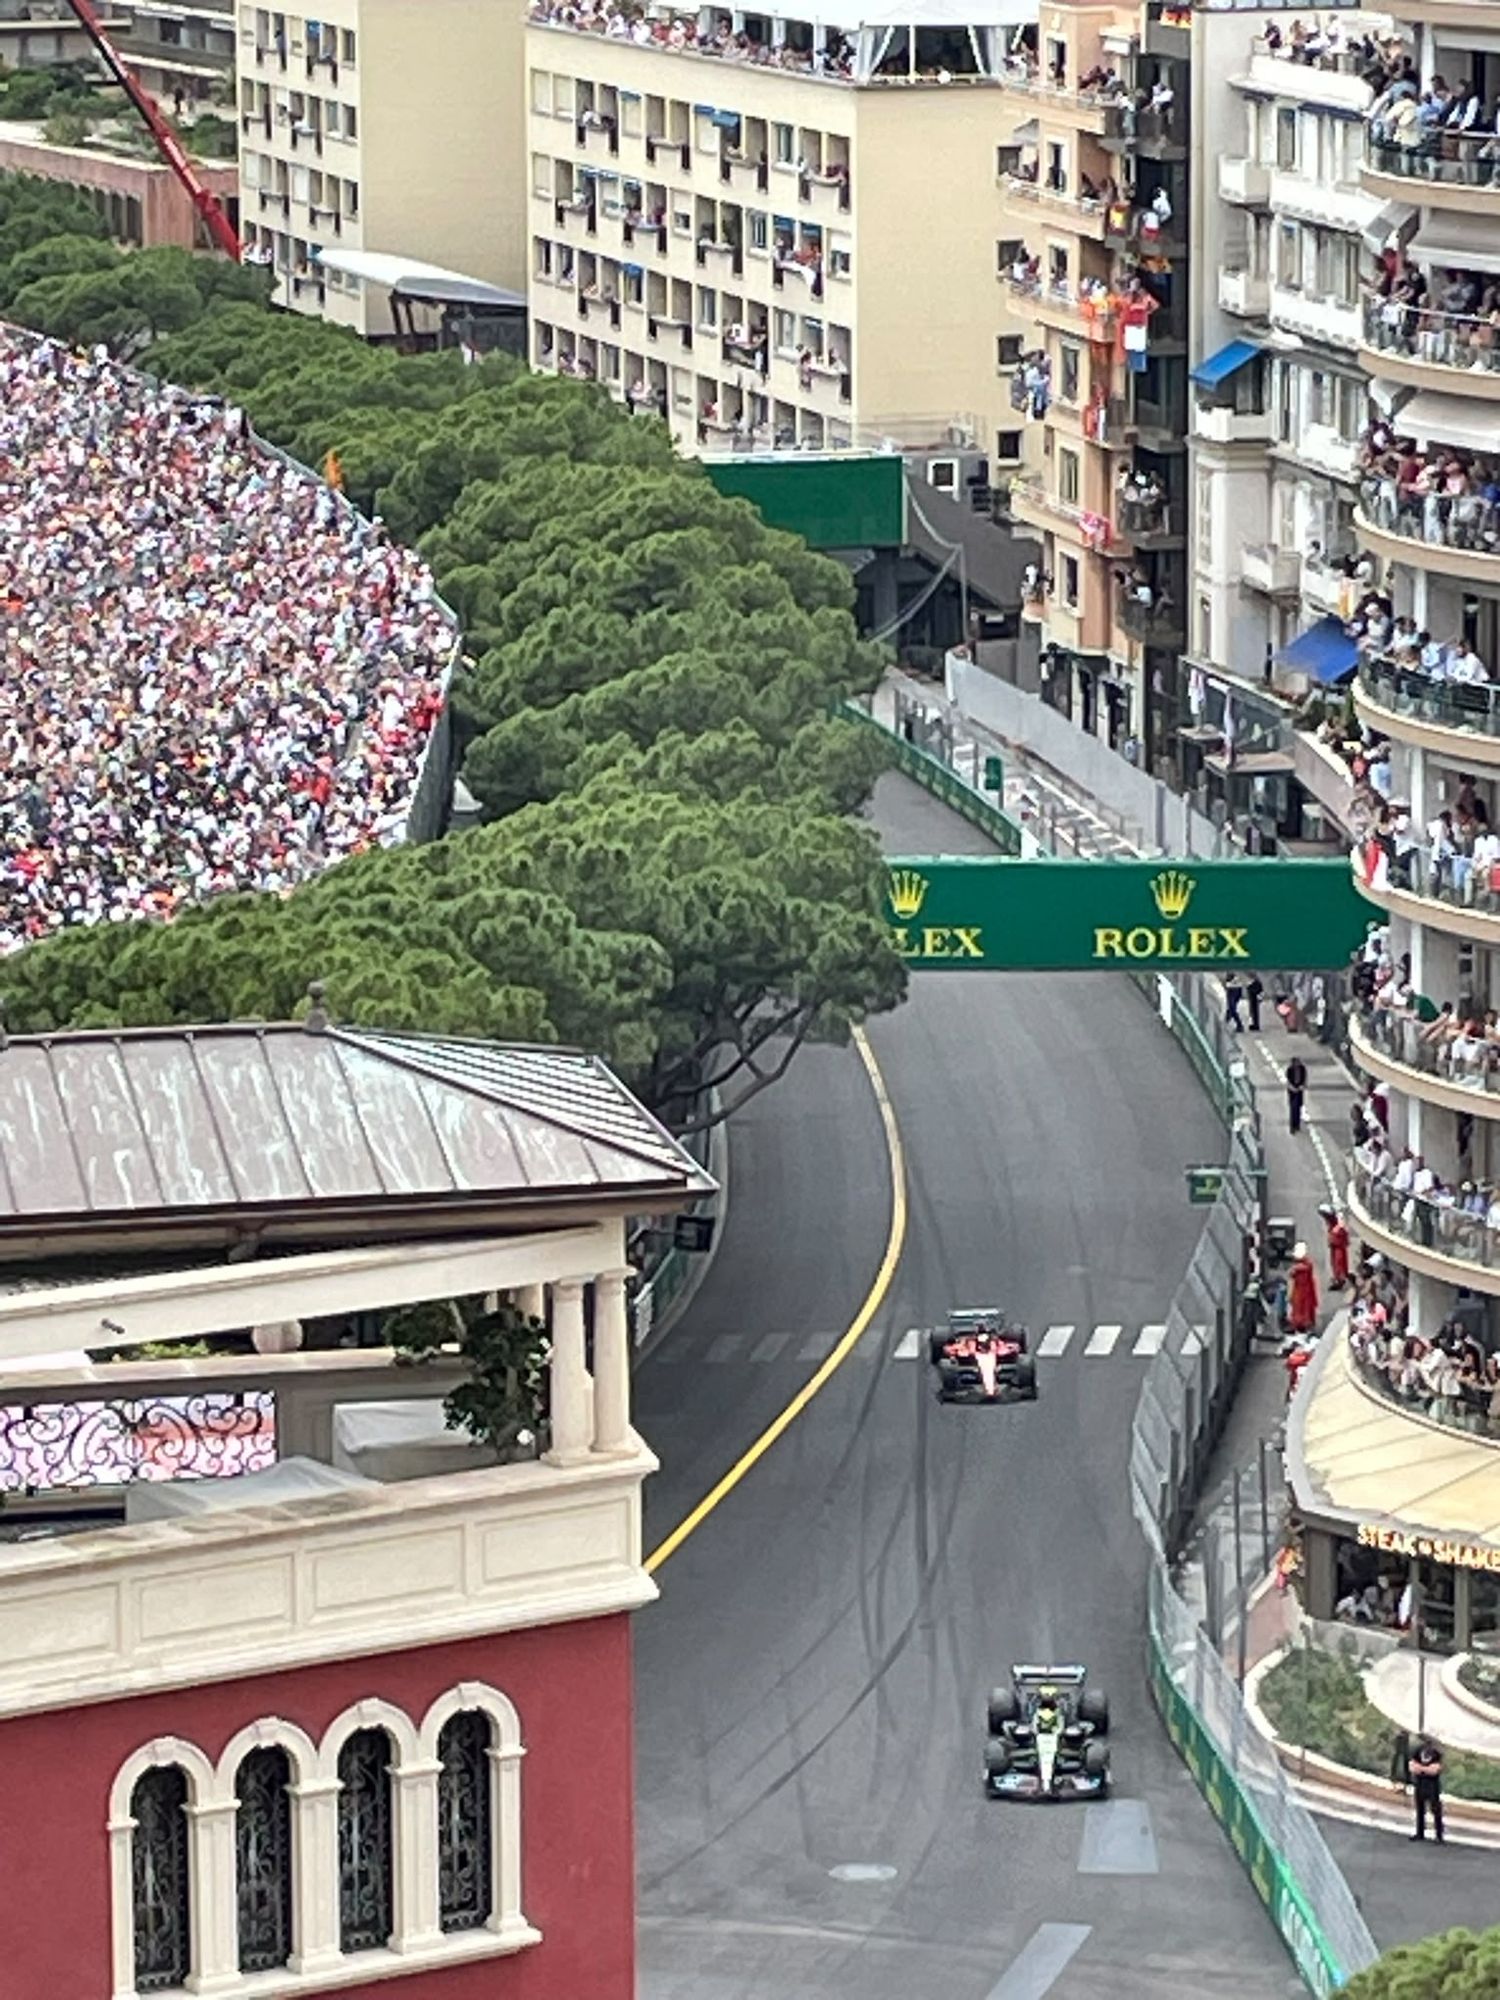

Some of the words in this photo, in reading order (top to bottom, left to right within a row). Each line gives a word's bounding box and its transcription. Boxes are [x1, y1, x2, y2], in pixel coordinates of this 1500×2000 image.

[893, 927, 985, 958] LEX
[1092, 927, 1250, 958] ROLEX
[1358, 1523, 1417, 1557] STEAK
